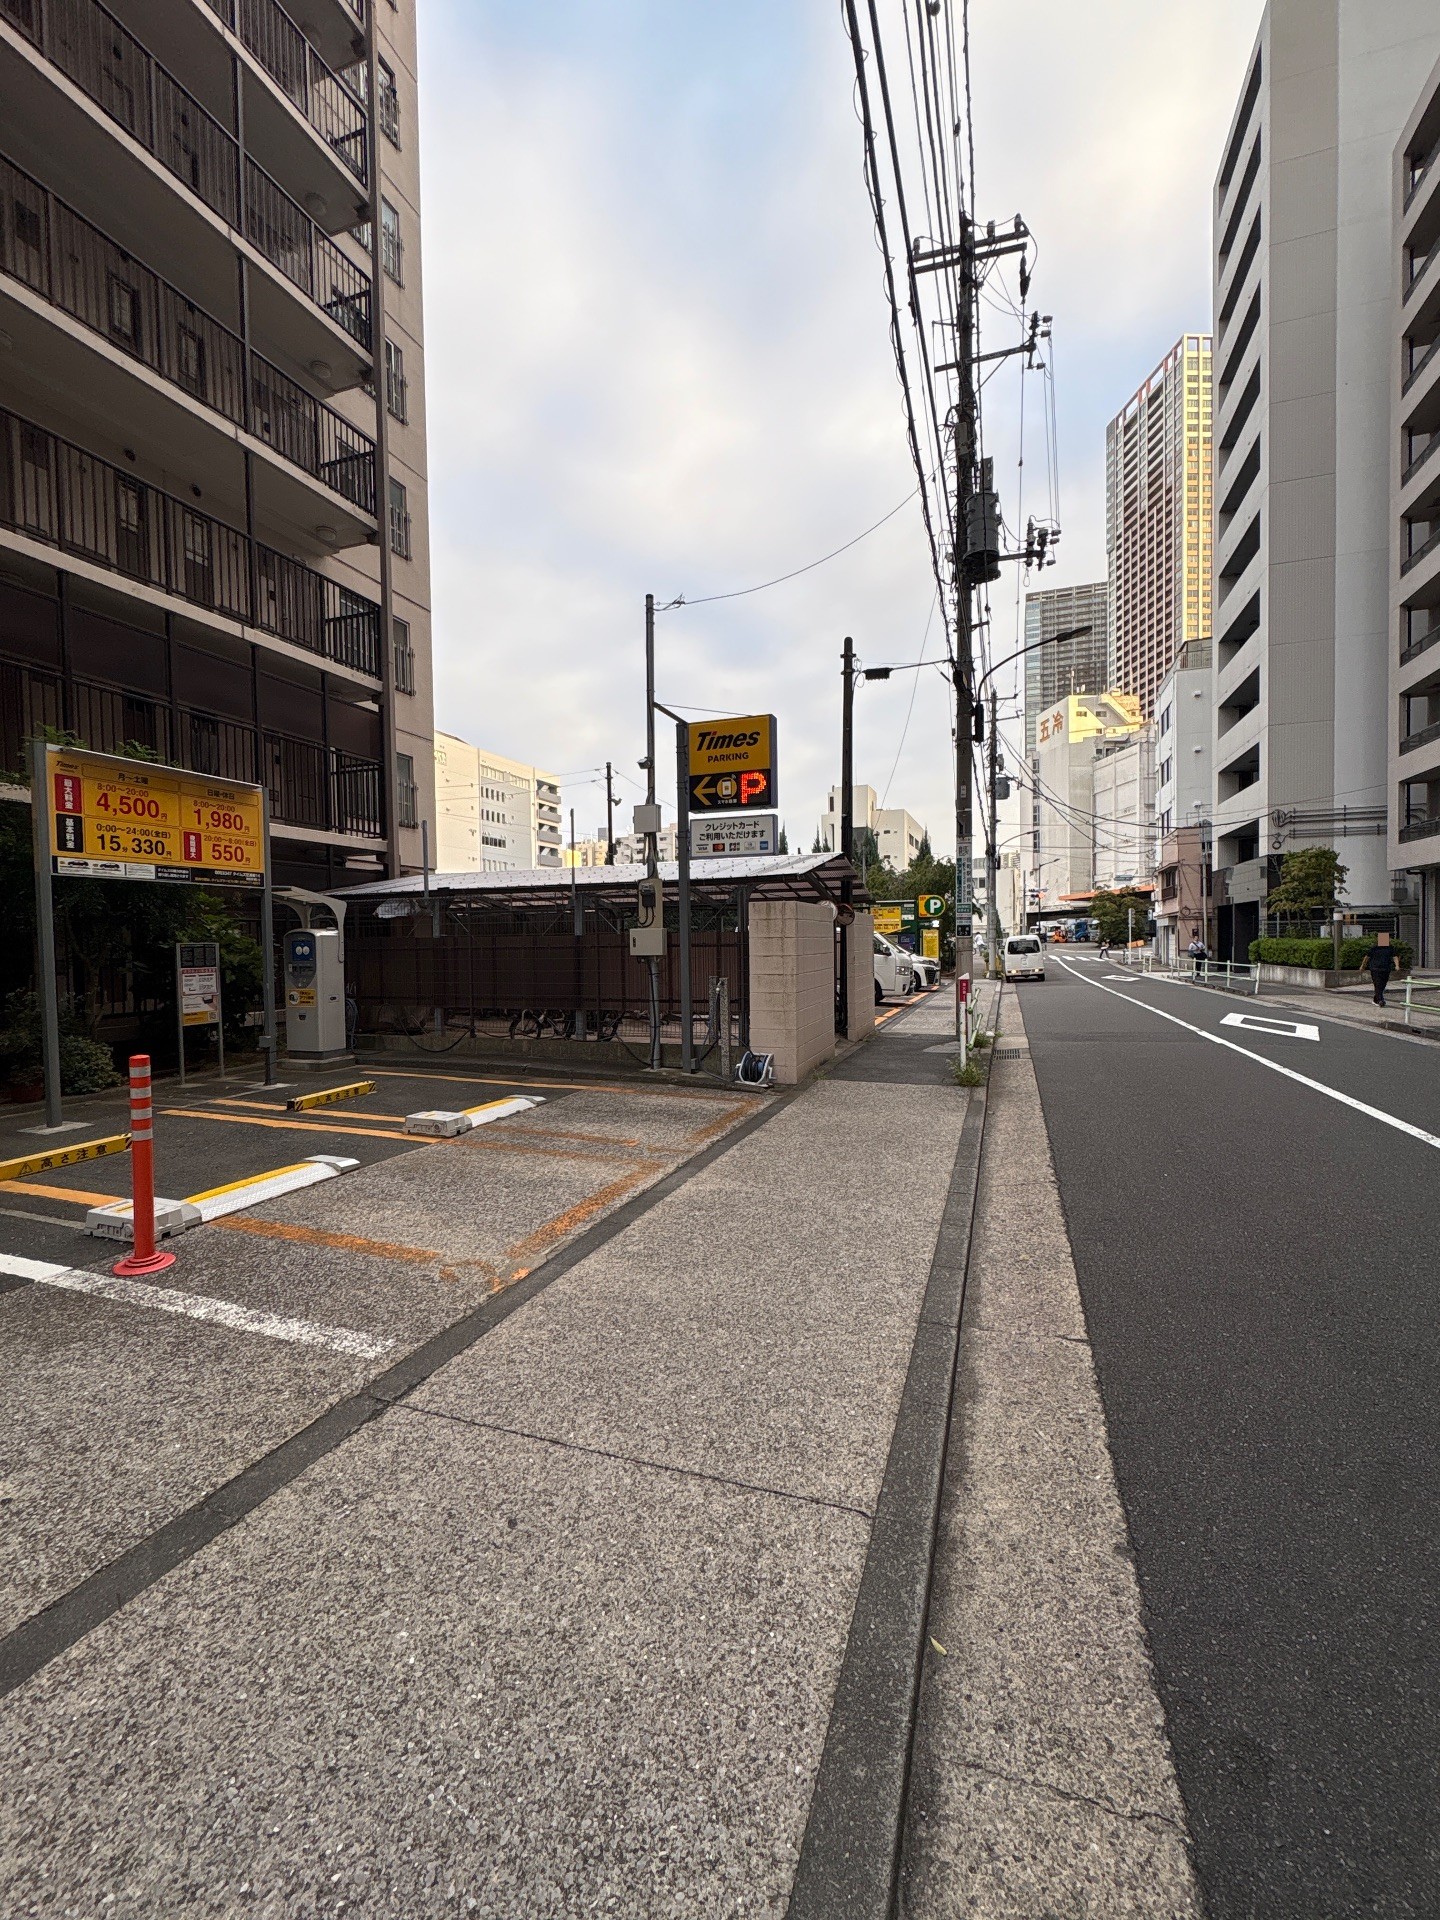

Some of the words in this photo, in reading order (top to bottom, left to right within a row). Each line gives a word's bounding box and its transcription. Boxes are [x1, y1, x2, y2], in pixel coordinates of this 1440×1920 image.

[696, 731, 761, 751] Times
[707, 751, 749, 763] PARKING
[740, 772, 767, 804] P
[705, 820, 760, 831] クレジットカード
[699, 829, 766, 841] ご利用いただけます
[929, 899, 942, 914] P
[41, 1144, 107, 1169] 高さ注意
